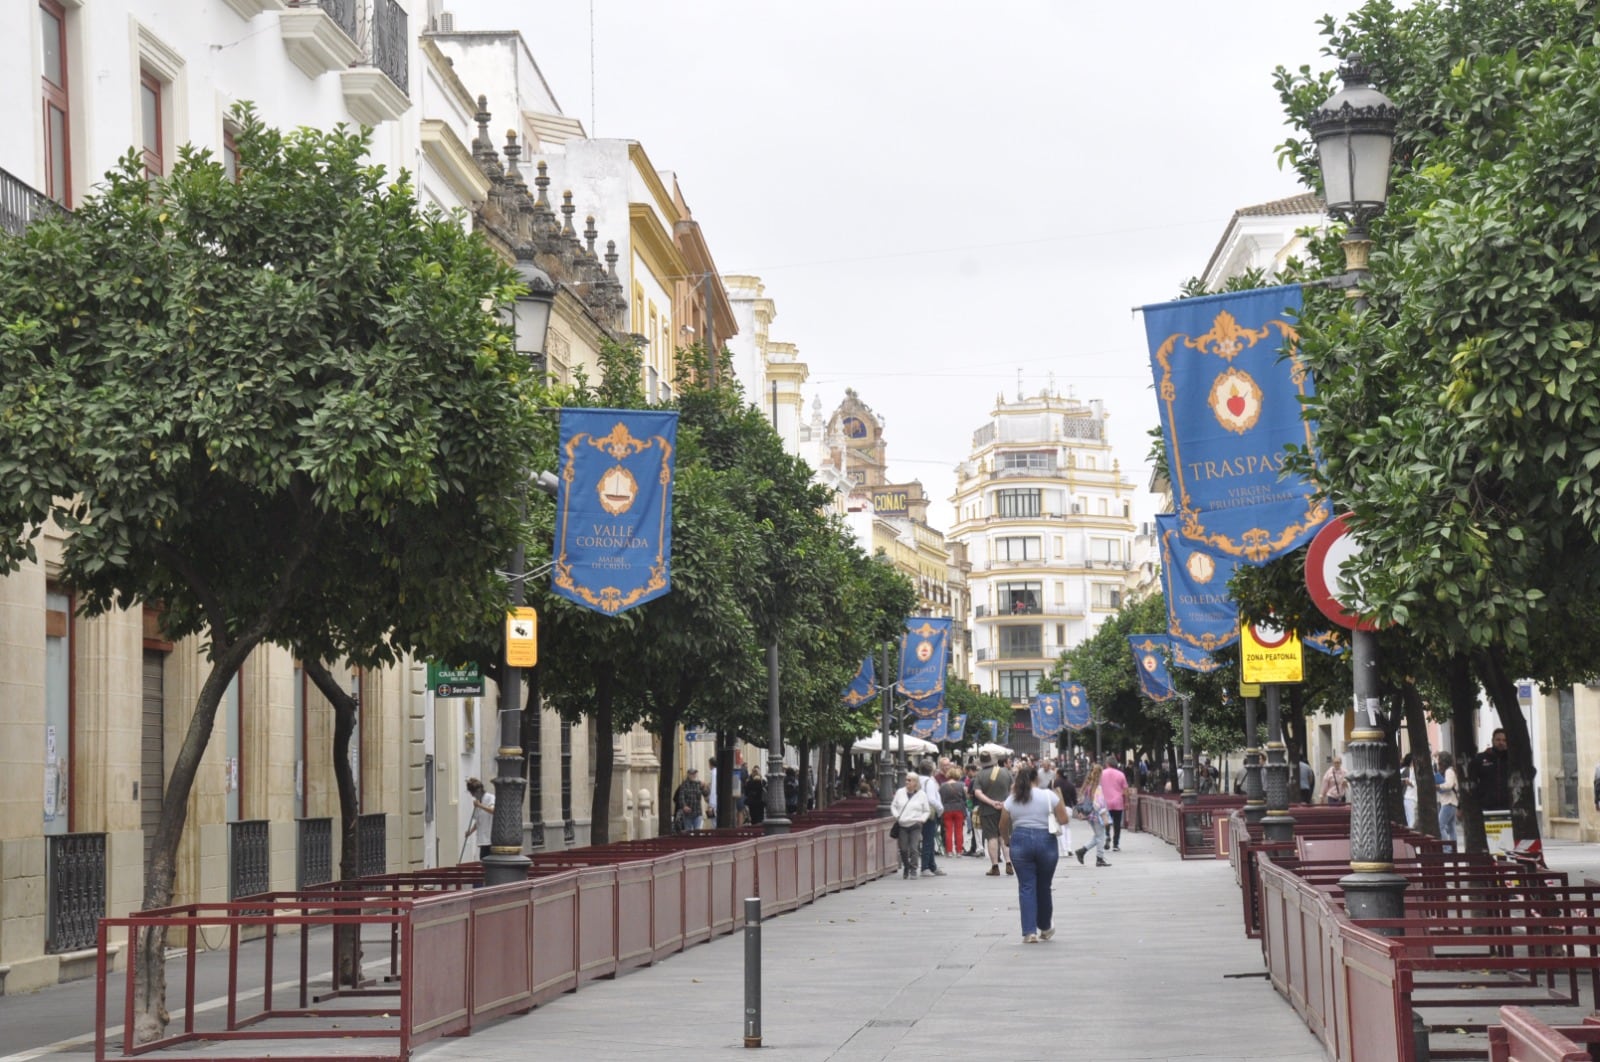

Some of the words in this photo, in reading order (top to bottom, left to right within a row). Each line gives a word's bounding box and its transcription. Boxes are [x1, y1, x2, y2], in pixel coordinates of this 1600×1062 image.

[1188, 451, 1287, 480] TRASPAS
[1228, 484, 1271, 497] VIRGEN
[874, 492, 907, 511] COÑAC
[593, 524, 634, 537] VALLE
[576, 536, 648, 548] CORONADA
[1265, 653, 1297, 661] PEATONAL
